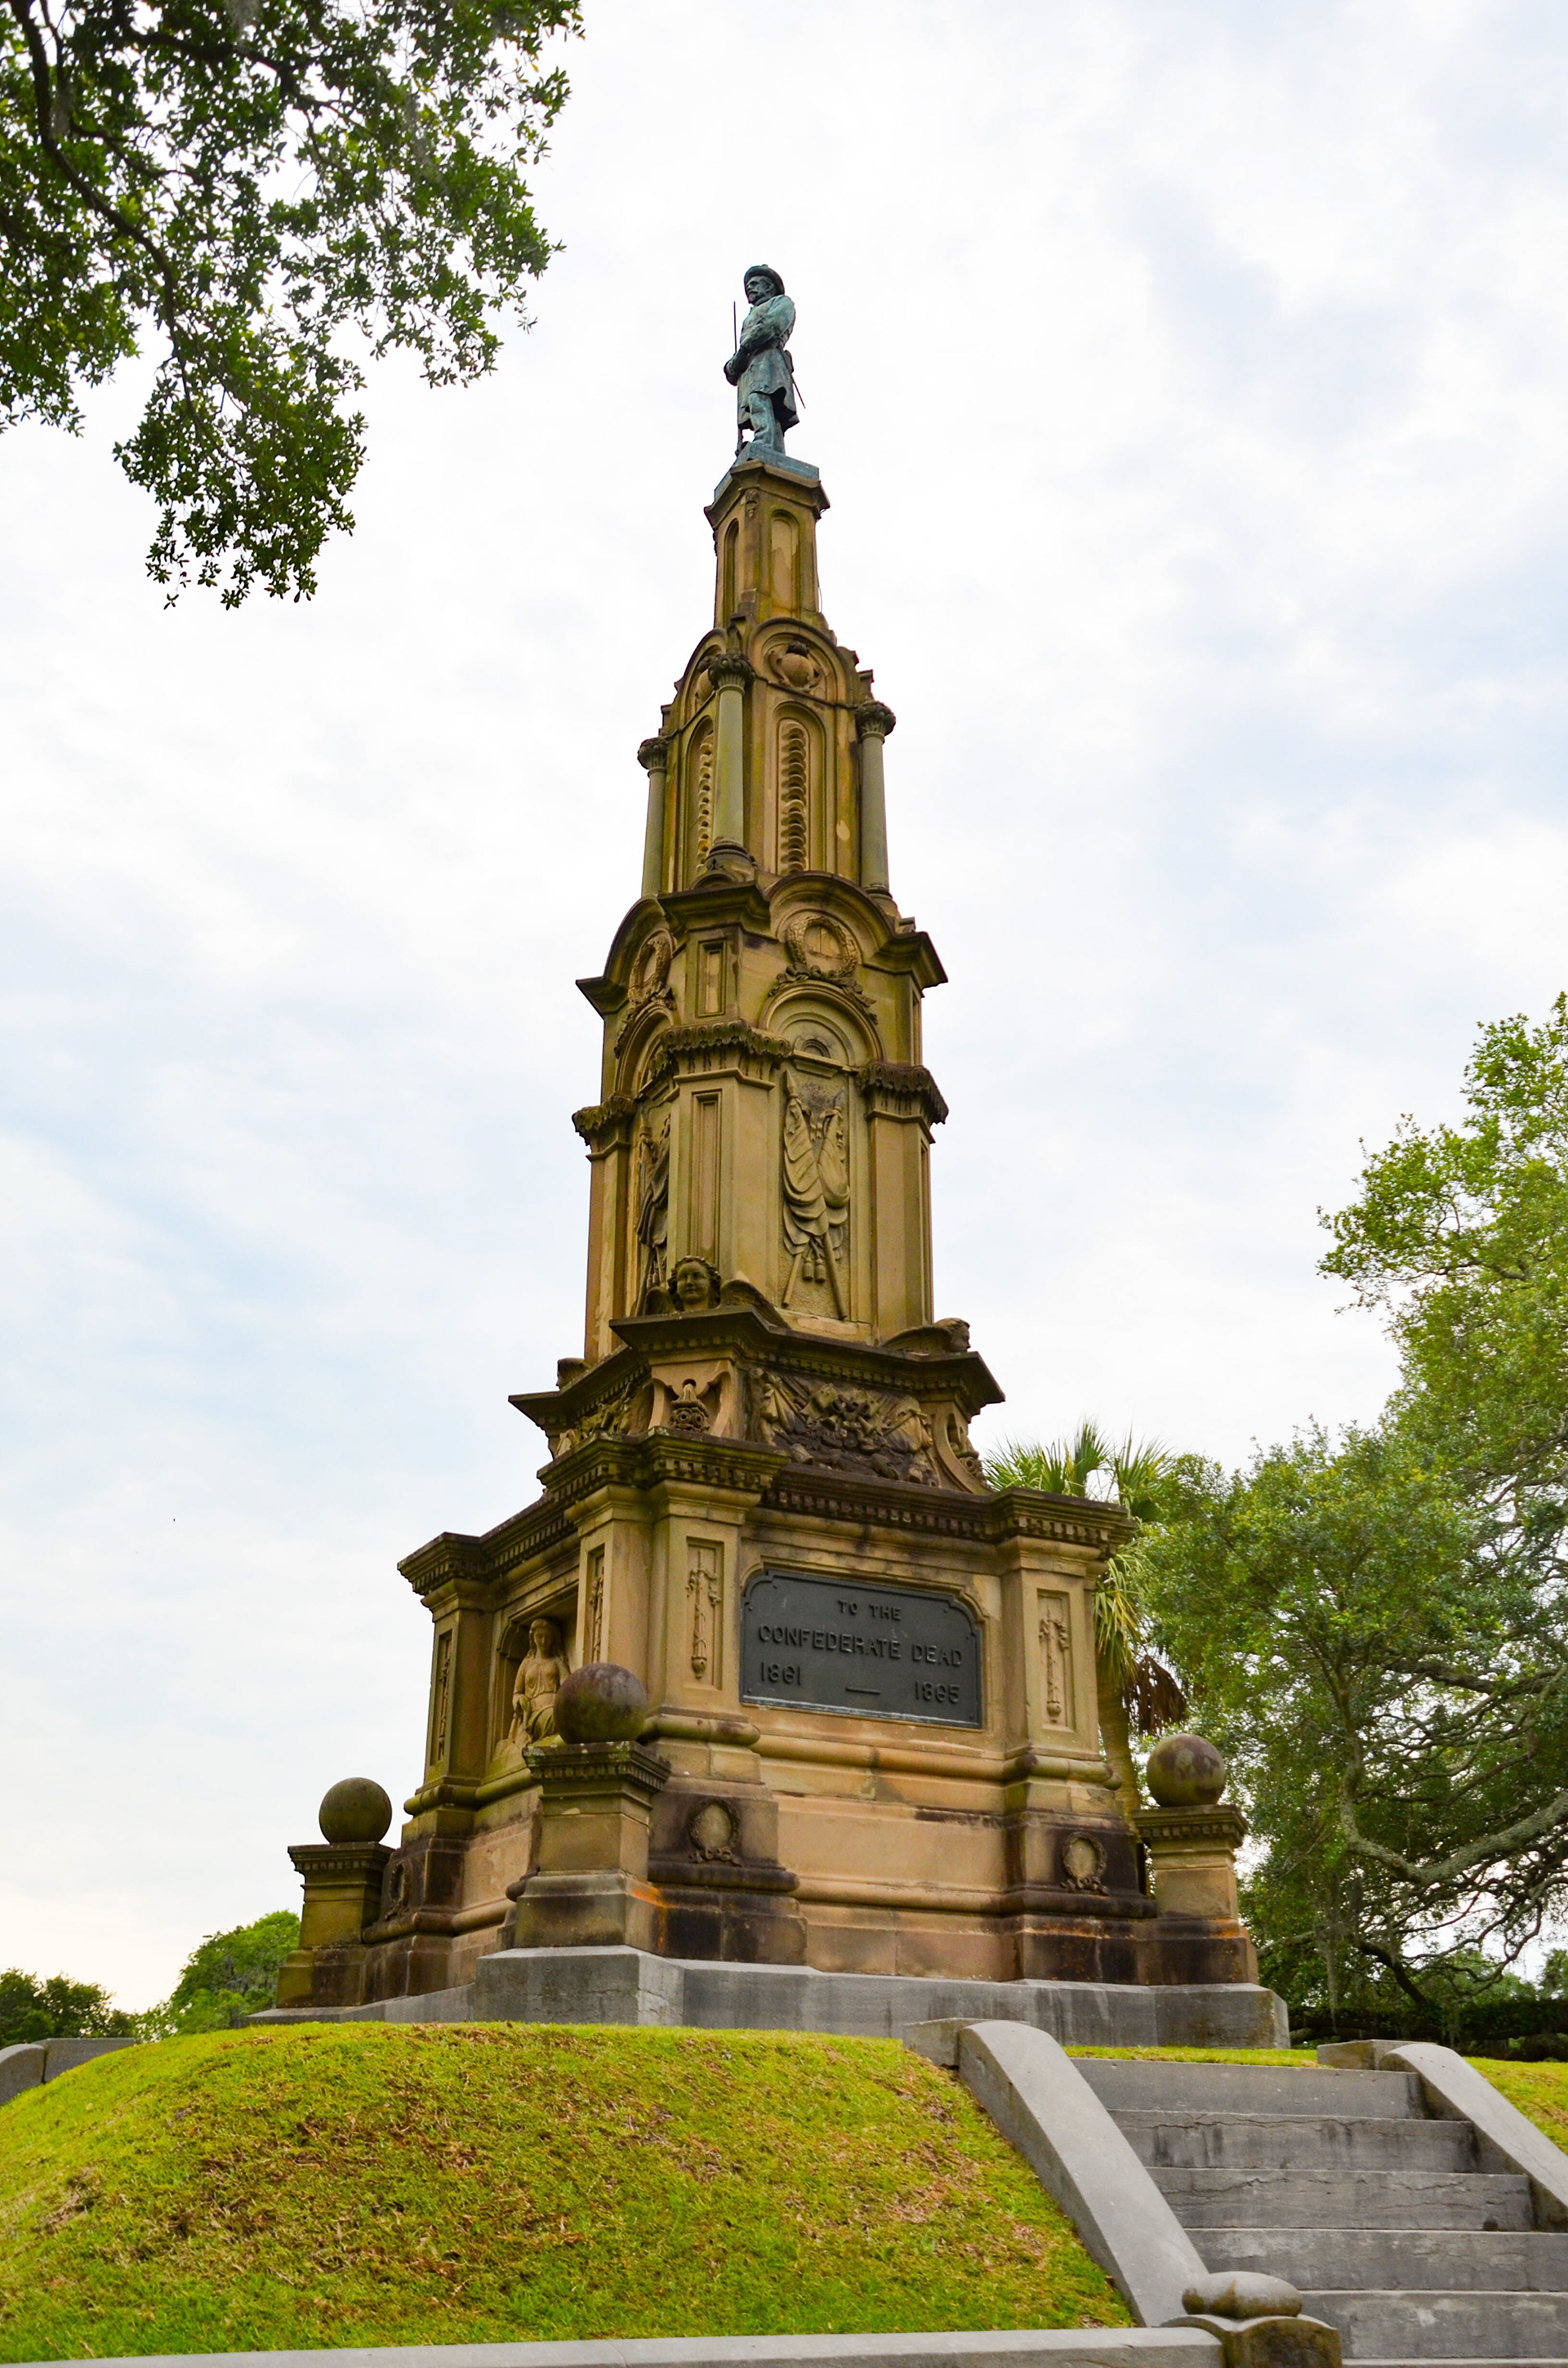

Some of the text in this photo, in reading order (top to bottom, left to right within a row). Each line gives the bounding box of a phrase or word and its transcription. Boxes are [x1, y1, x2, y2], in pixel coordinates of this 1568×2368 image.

[838, 1599, 902, 1621] TO THE
[758, 1625, 962, 1667] CONFEDERATE DEAD
[760, 1661, 802, 1686] 1861
[915, 1680, 960, 1704] 1865
